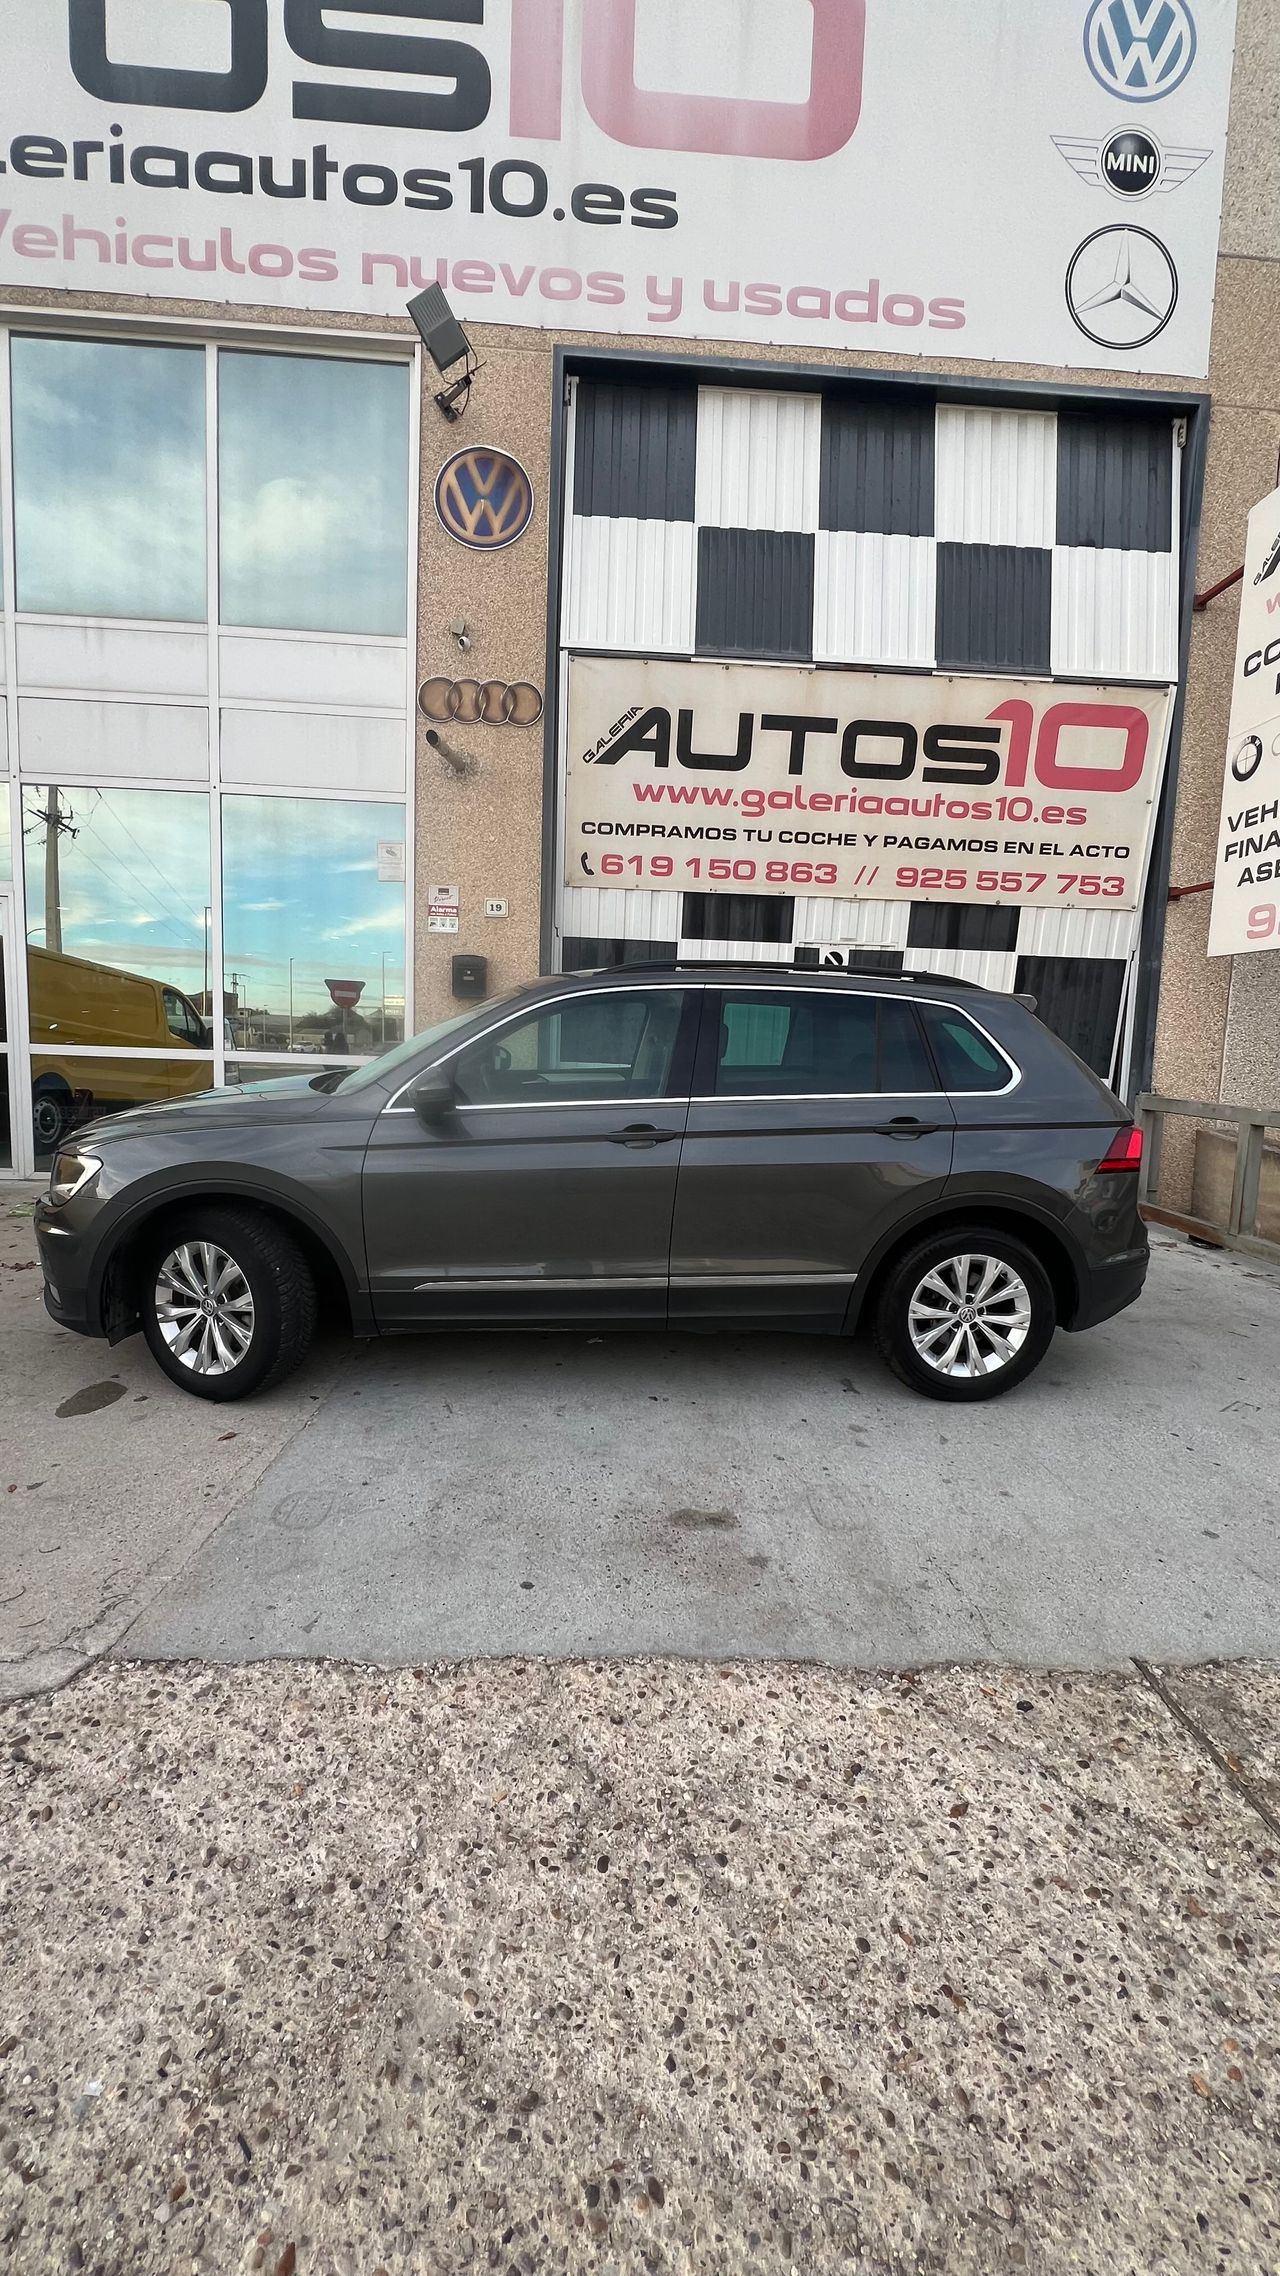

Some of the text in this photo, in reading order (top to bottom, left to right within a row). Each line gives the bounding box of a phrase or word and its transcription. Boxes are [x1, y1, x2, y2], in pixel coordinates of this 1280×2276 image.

[0, 124, 679, 230] eriaautos10.es
[1107, 151, 1155, 174] MINI
[360, 250, 626, 305] nuevos
[646, 275, 684, 324] y
[704, 279, 966, 331] usados
[1253, 530, 1280, 585] GALE
[582, 706, 645, 764] GALERIA
[632, 783, 1087, 826] www.galeriaautos10.es
[1227, 799, 1279, 833] VEH
[581, 821, 1130, 859] COMPRAMOS TU COCHE Y PAGAMOS EN EL ACTO
[600, 853, 674, 877] 619
[686, 856, 757, 882] 150
[765, 860, 838, 886] 863
[895, 866, 969, 892] 925
[976, 869, 1048, 894] 557
[1057, 873, 1126, 897] 753
[430, 905, 458, 913] Alarma
[490, 903, 502, 912] 19
[1247, 904, 1280, 939] 9
